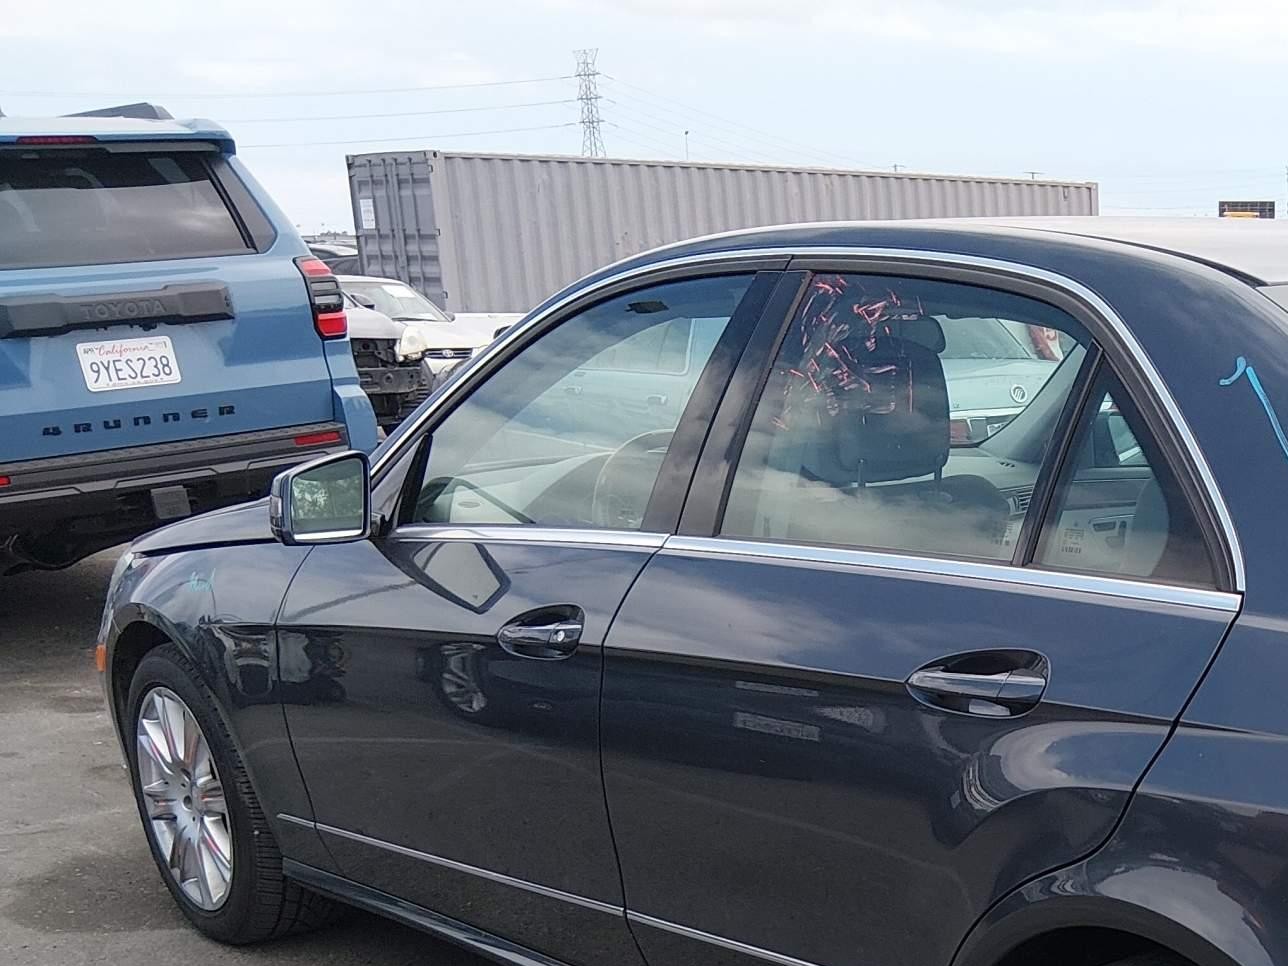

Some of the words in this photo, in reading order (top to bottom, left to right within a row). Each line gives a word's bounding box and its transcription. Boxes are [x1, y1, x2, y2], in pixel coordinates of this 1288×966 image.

[80, 299, 167, 320] TOYOTA
[97, 342, 151, 358] California
[89, 355, 173, 384] 9YES238
[42, 405, 236, 437] 4RUNNER
